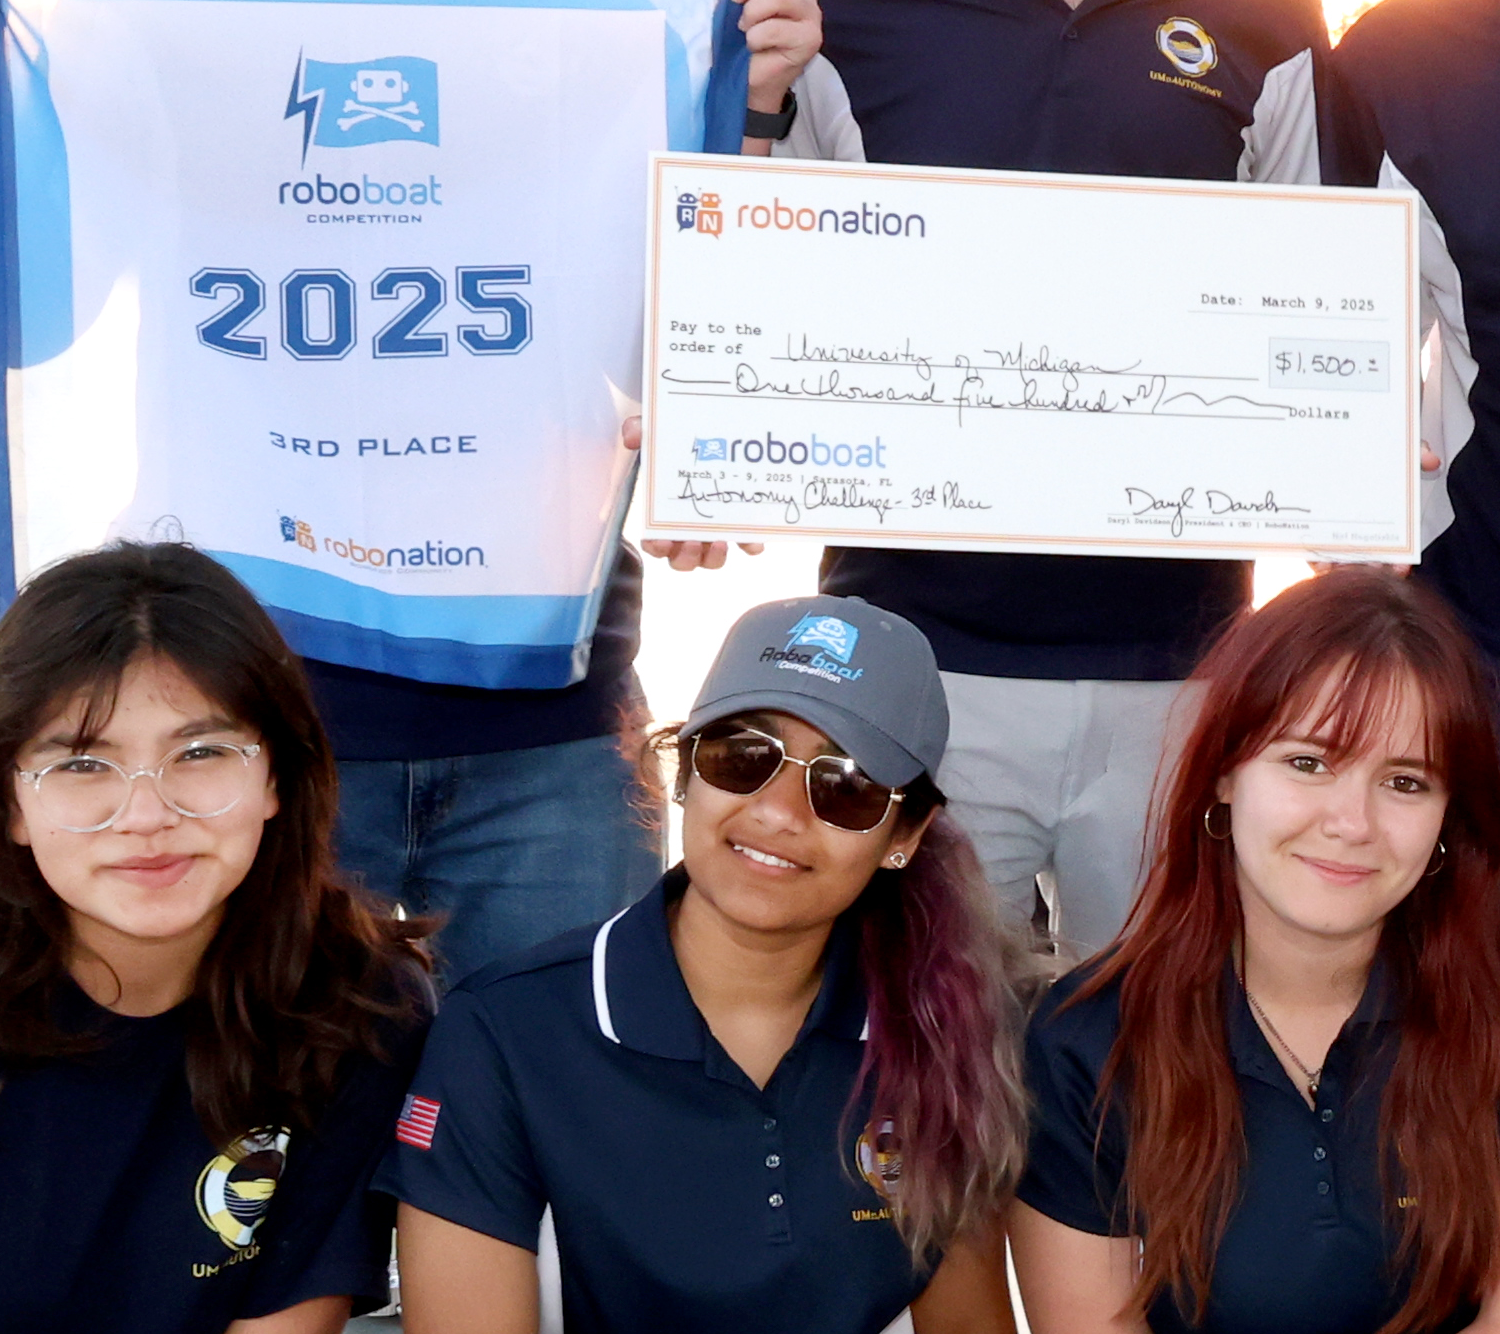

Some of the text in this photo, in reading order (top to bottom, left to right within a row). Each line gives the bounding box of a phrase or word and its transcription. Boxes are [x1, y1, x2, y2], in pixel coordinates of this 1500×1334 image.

[279, 173, 442, 205] roboboat
[307, 214, 422, 223] COMPETITION
[737, 197, 925, 238] robonation
[189, 264, 533, 361] 2025
[1201, 293, 1375, 312] Date: March 9, 2025
[670, 321, 762, 336] Pay to the
[669, 342, 744, 355] order of
[788, 333, 933, 381] University
[984, 342, 1141, 392] Michigan
[736, 363, 800, 393] One
[1288, 406, 1350, 420] Dollars
[269, 432, 478, 457] 3RD PLACE
[730, 432, 887, 468] roboboat
[678, 470, 712, 479] March
[719, 472, 726, 480] 3
[746, 473, 758, 483] 9,
[766, 474, 793, 483] 2025
[813, 476, 870, 487] Sarasota,
[879, 478, 893, 486] FL
[678, 478, 801, 524] Autonomy
[910, 487, 937, 509] 3rd
[943, 482, 993, 510] Place
[324, 538, 484, 567] robonation
